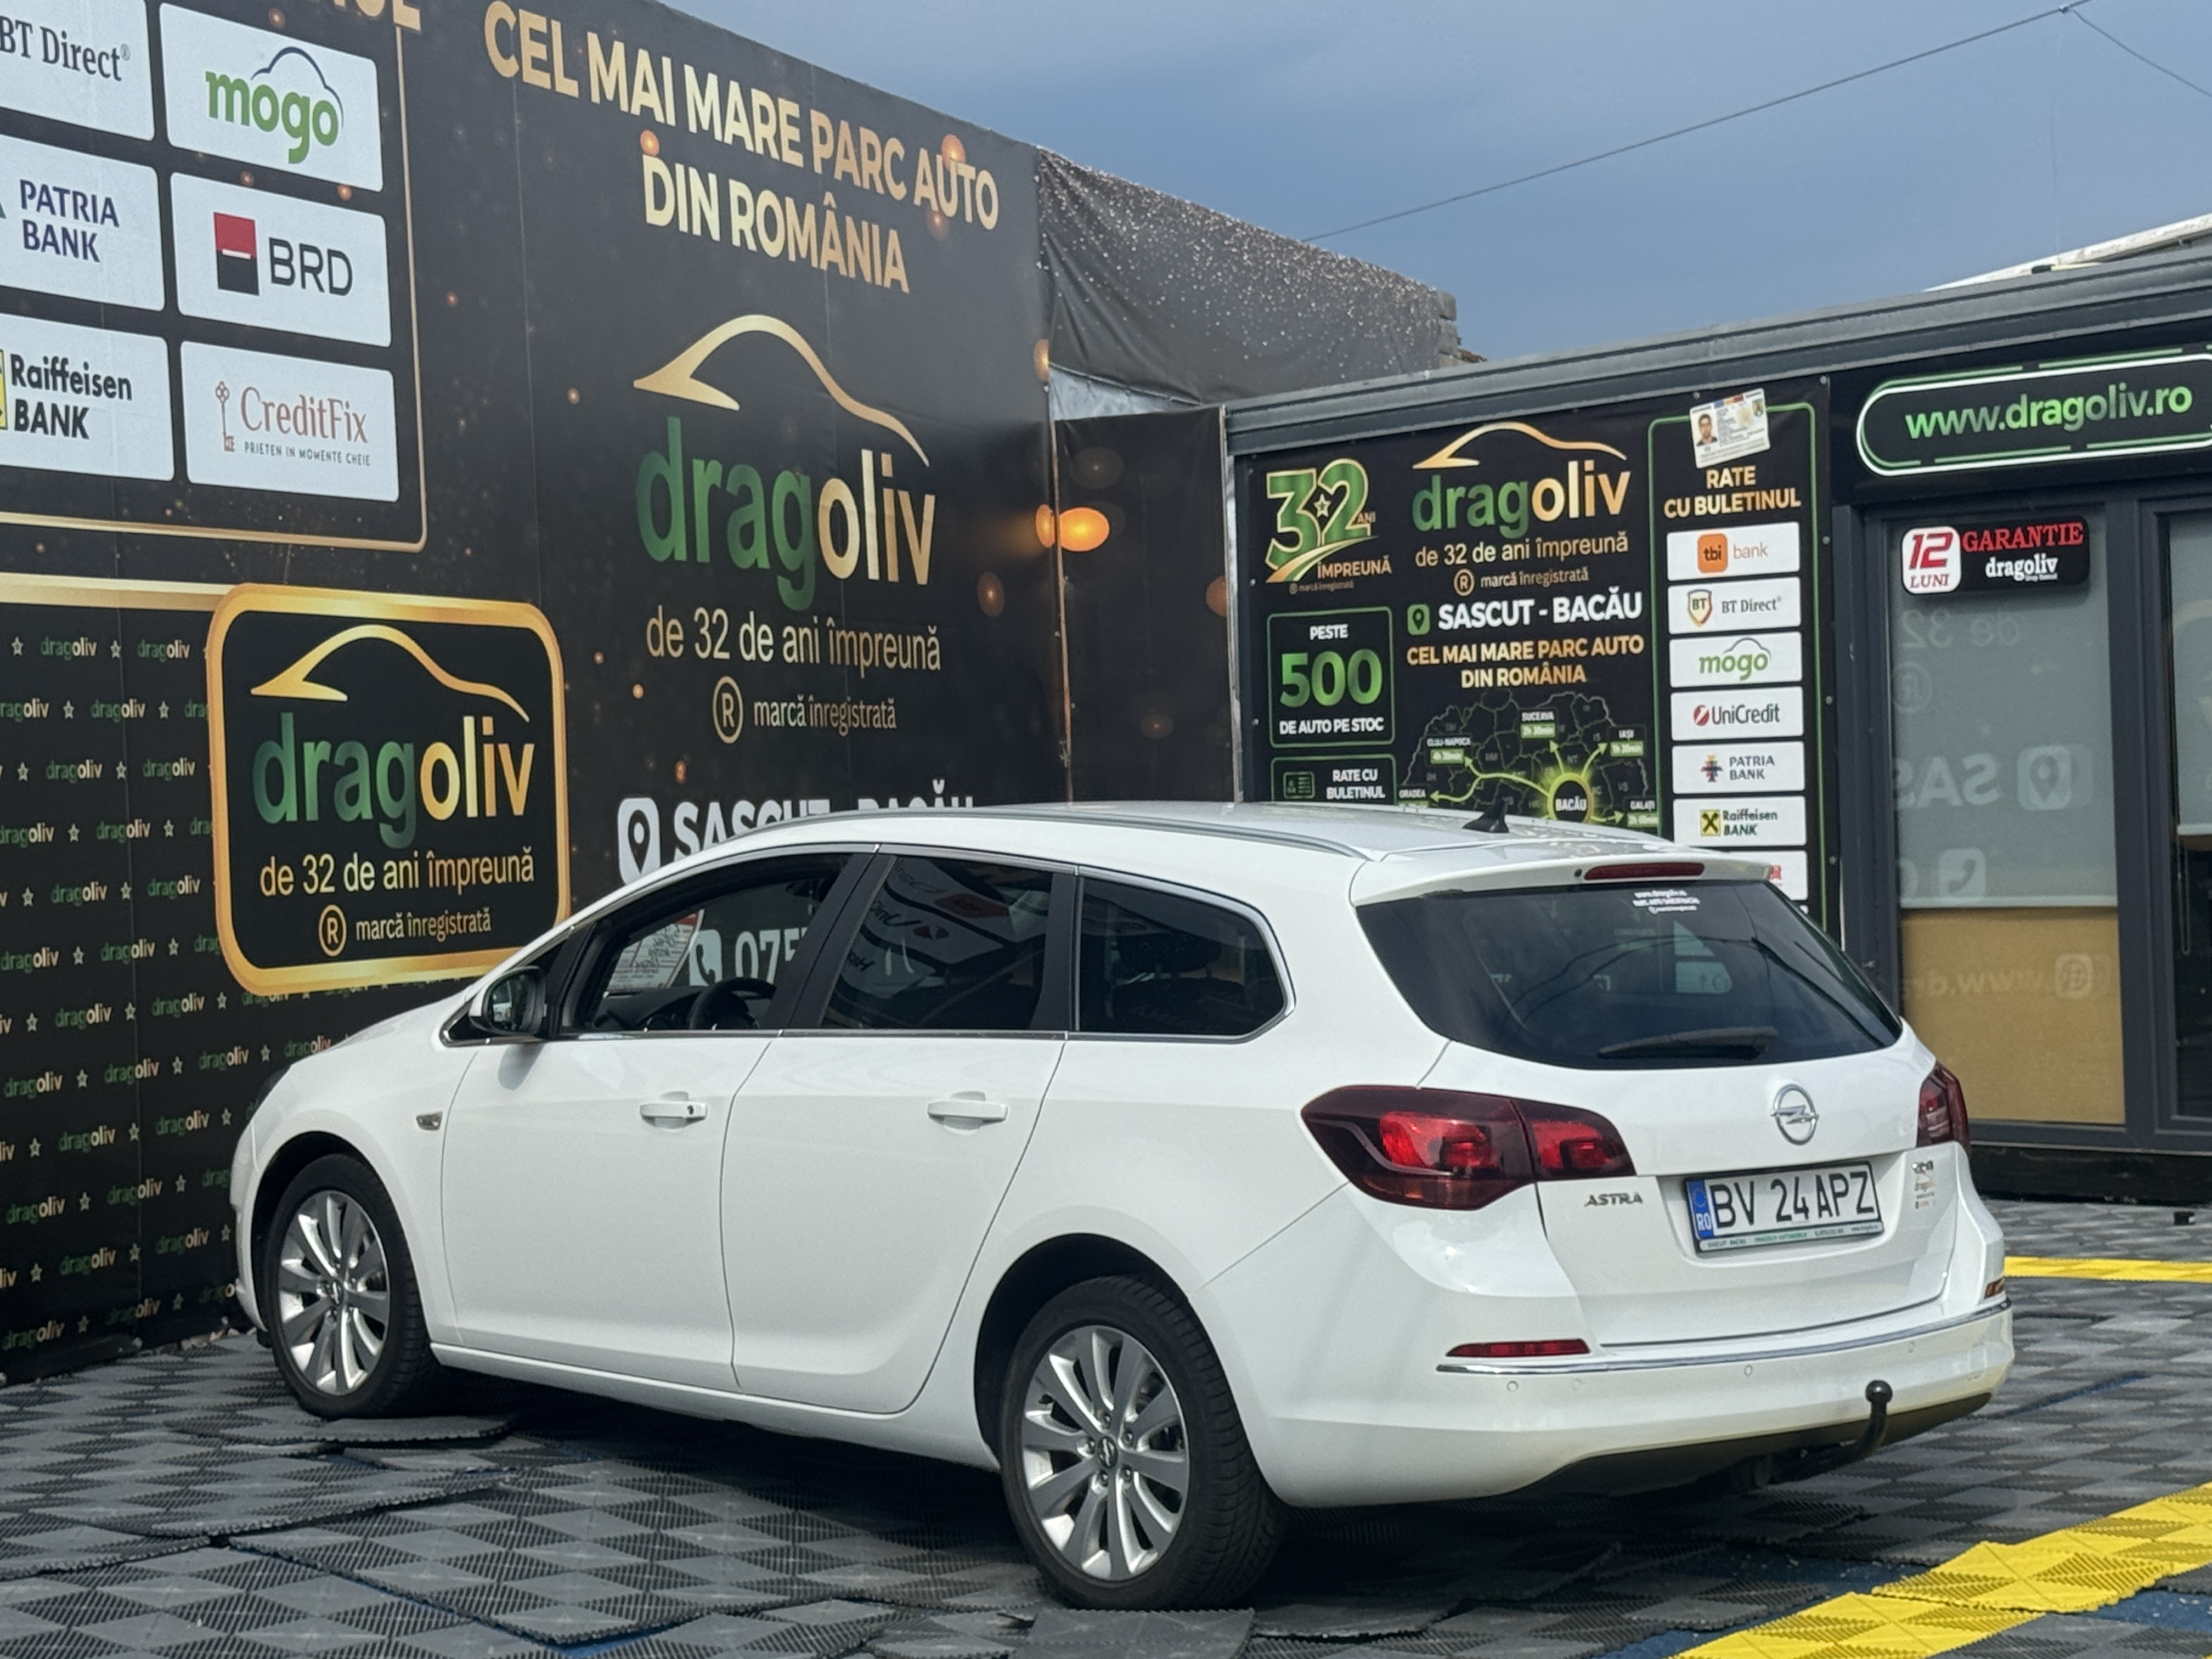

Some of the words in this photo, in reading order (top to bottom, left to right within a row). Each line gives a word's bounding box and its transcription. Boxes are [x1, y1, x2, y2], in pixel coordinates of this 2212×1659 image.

[205, 70, 340, 165] mogo
[483, 1, 579, 98] CEL
[587, 31, 676, 127] MAI
[683, 63, 804, 168] MARE
[810, 108, 906, 201] PARC
[913, 147, 999, 230] AUTO
[20, 179, 120, 228] PATRIA
[22, 219, 100, 263] BANK
[642, 154, 721, 242] DIN
[728, 178, 910, 294] ROMÂNIA
[268, 236, 353, 296] BRD
[10, 353, 132, 400] Raiffeisen
[14, 399, 90, 440] BANK
[240, 386, 368, 443] CreditFix
[1905, 382, 2193, 439] www.dragoliv.ro
[244, 441, 282, 456] PRIETEN
[299, 448, 342, 464] MOMENTE
[346, 453, 370, 467] CHEIE
[1706, 465, 1756, 489] RATE
[635, 415, 935, 611] dragoliv
[1265, 458, 1370, 571] 32
[1412, 459, 1631, 539] dragoliv
[1664, 497, 1690, 518] CU
[1694, 487, 1802, 516] BULETINUL
[1415, 546, 1438, 567] de
[1444, 543, 1467, 565] 32
[1472, 541, 1496, 563] de
[1502, 539, 1530, 561] ani
[1536, 531, 1628, 562] împreună
[1703, 544, 1722, 561] tbi
[1733, 542, 1769, 559] bank
[1909, 532, 1953, 570] 12
[1962, 522, 2084, 552] GARANTIE
[1481, 572, 1517, 588] marcă
[1519, 566, 1589, 588] înregistrată
[1910, 573, 1949, 588] LUNI
[1985, 552, 2058, 582] dragoliv
[1438, 599, 1535, 630] SASCUT
[1553, 586, 1643, 623] BACĂU
[1722, 600, 1737, 614] BT
[41, 636, 97, 661] dragoliv
[137, 639, 190, 662] dragoliv
[646, 605, 684, 658] de
[694, 607, 730, 660] 32
[740, 610, 774, 662] de
[782, 615, 821, 664] ani
[826, 617, 941, 679] împreună
[1310, 624, 1349, 640] PESTE
[1407, 646, 1440, 665] CEL
[1443, 644, 1477, 664] MAI
[1481, 641, 1534, 662] MARE
[1538, 637, 1588, 659] PARC
[1591, 635, 1644, 656] AUTO
[1699, 653, 1769, 681] mogo
[1280, 648, 1383, 707] 500
[1462, 669, 1493, 688] DIN
[1497, 662, 1587, 687] ROMÂNIA
[0, 697, 49, 723] ragoliv
[91, 698, 145, 723] dragoliv
[754, 694, 807, 727] marcă
[809, 694, 897, 737] înregistrată
[1279, 720, 1296, 735] DE
[1298, 719, 1331, 733] AUTO
[1334, 719, 1350, 732] PE
[1351, 718, 1384, 732] STOC
[1711, 703, 1780, 725] UniCredit
[46, 759, 103, 784] dragoliv
[143, 757, 196, 781] dragoliv
[1333, 769, 1361, 782] RATE
[1362, 769, 1378, 781] CU
[1729, 755, 1775, 768] PATRIA
[1729, 769, 1765, 781] BANK
[252, 712, 535, 849] dragoliv
[1327, 786, 1386, 799] BULETINUL
[1556, 796, 1587, 811] BACĂU
[1723, 808, 1778, 822] Raiffeisen
[97, 819, 151, 844] dragoliv
[1723, 823, 1758, 836] BANK
[260, 855, 294, 896] de
[302, 853, 335, 895] 32
[343, 851, 375, 892] de
[383, 850, 419, 890] ani
[426, 846, 534, 895] împreună
[51, 881, 108, 907] dragoliv
[148, 875, 201, 899] dragoliv
[356, 912, 404, 941] marcă
[407, 907, 492, 942] înregistrată
[1, 946, 59, 974] dragoliv
[100, 938, 155, 964] dragoliv
[55, 1002, 112, 1030] dragoliv
[152, 992, 205, 1018] dragoliv
[3, 1070, 63, 1098] dragoliv
[104, 1058, 160, 1084] dragoliv
[198, 1045, 250, 1072] dragoliv
[58, 1125, 116, 1152] dragoliv
[155, 1109, 210, 1136] dragoliv
[5, 1196, 66, 1224] dragoliv
[107, 1178, 163, 1205] dragoliv
[1584, 1192, 1644, 1207] ASTRA
[1709, 1180, 1754, 1228] BV
[1770, 1176, 1809, 1224] 24
[1815, 1171, 1875, 1219] APZ
[1697, 1213, 1713, 1232] RO
[59, 1247, 117, 1276] dragoliv
[156, 1227, 210, 1254] dragoliv
[2, 1319, 65, 1351] dragoliv
[106, 1297, 161, 1325] dragoliv
